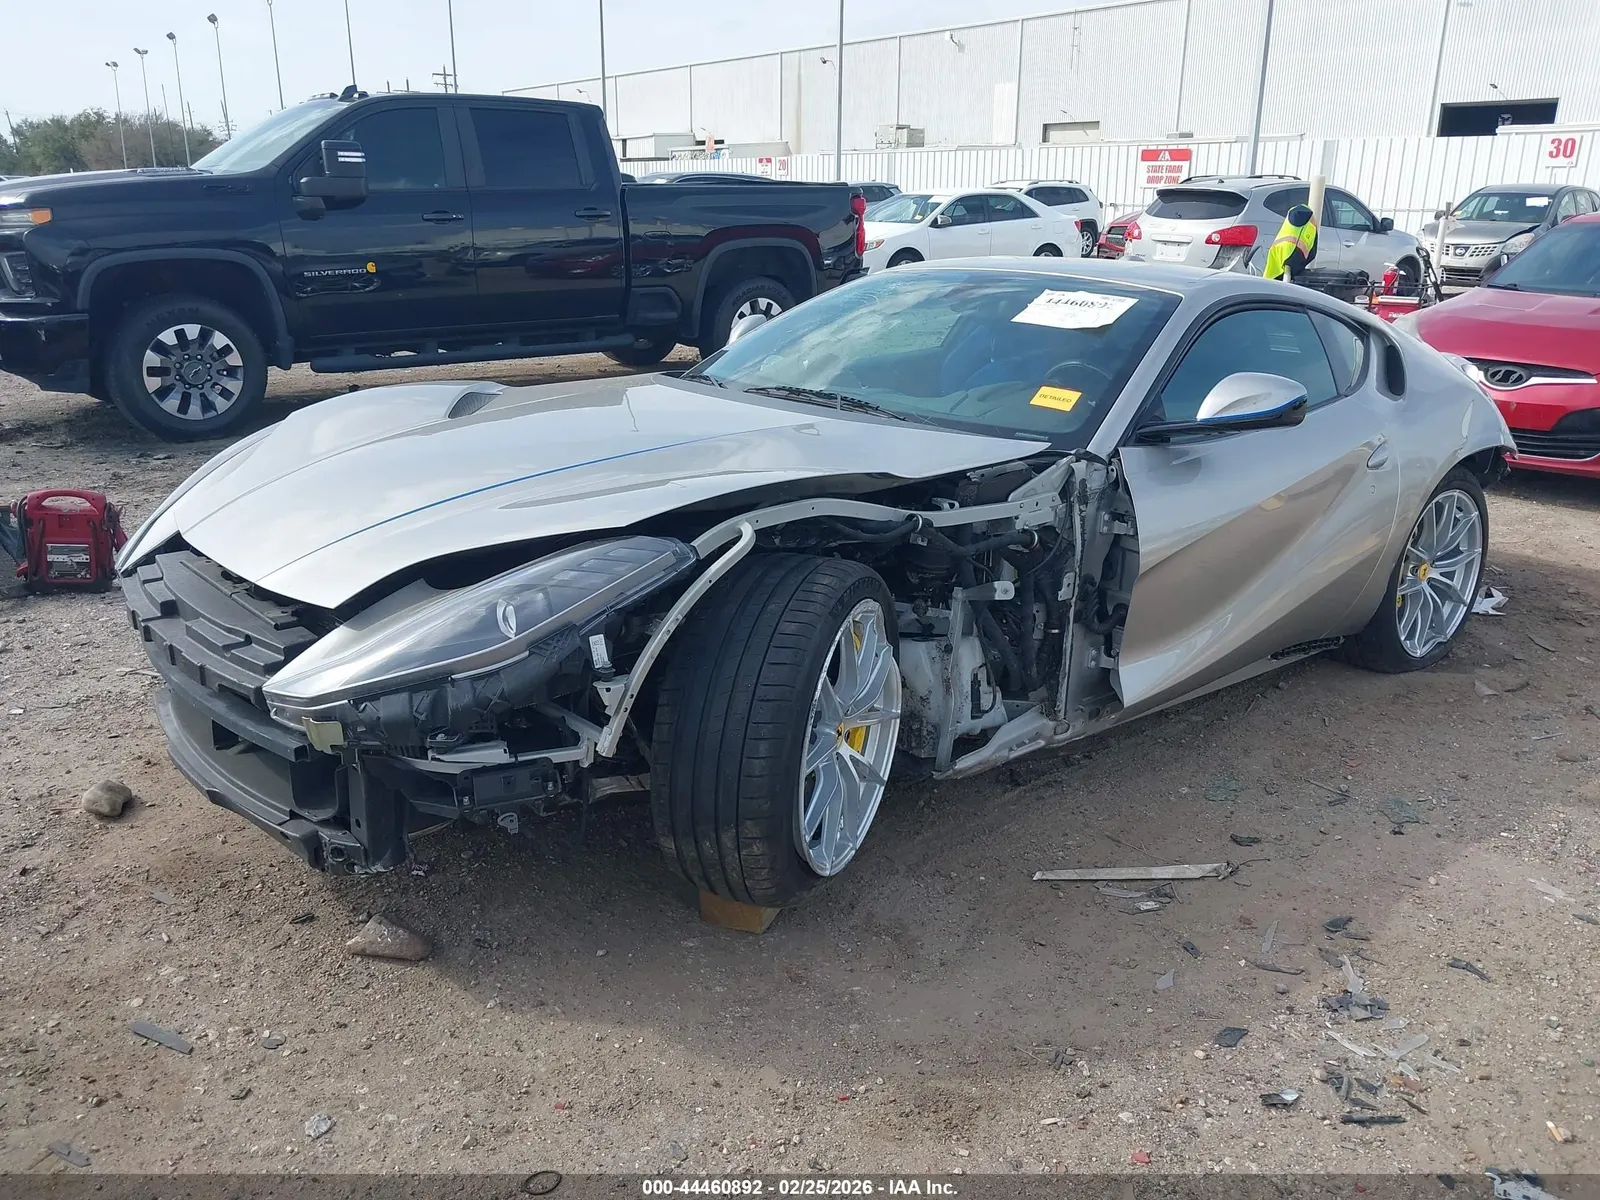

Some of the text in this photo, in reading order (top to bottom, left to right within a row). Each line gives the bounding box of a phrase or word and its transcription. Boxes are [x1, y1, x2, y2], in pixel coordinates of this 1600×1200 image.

[1549, 138, 1576, 158] 30
[778, 159, 787, 171] 20
[1146, 165, 1183, 174] STATE FARM
[1146, 175, 1181, 184] DROP ZONE
[303, 268, 367, 278] SILVERADO
[1039, 393, 1072, 404] DETAILED
